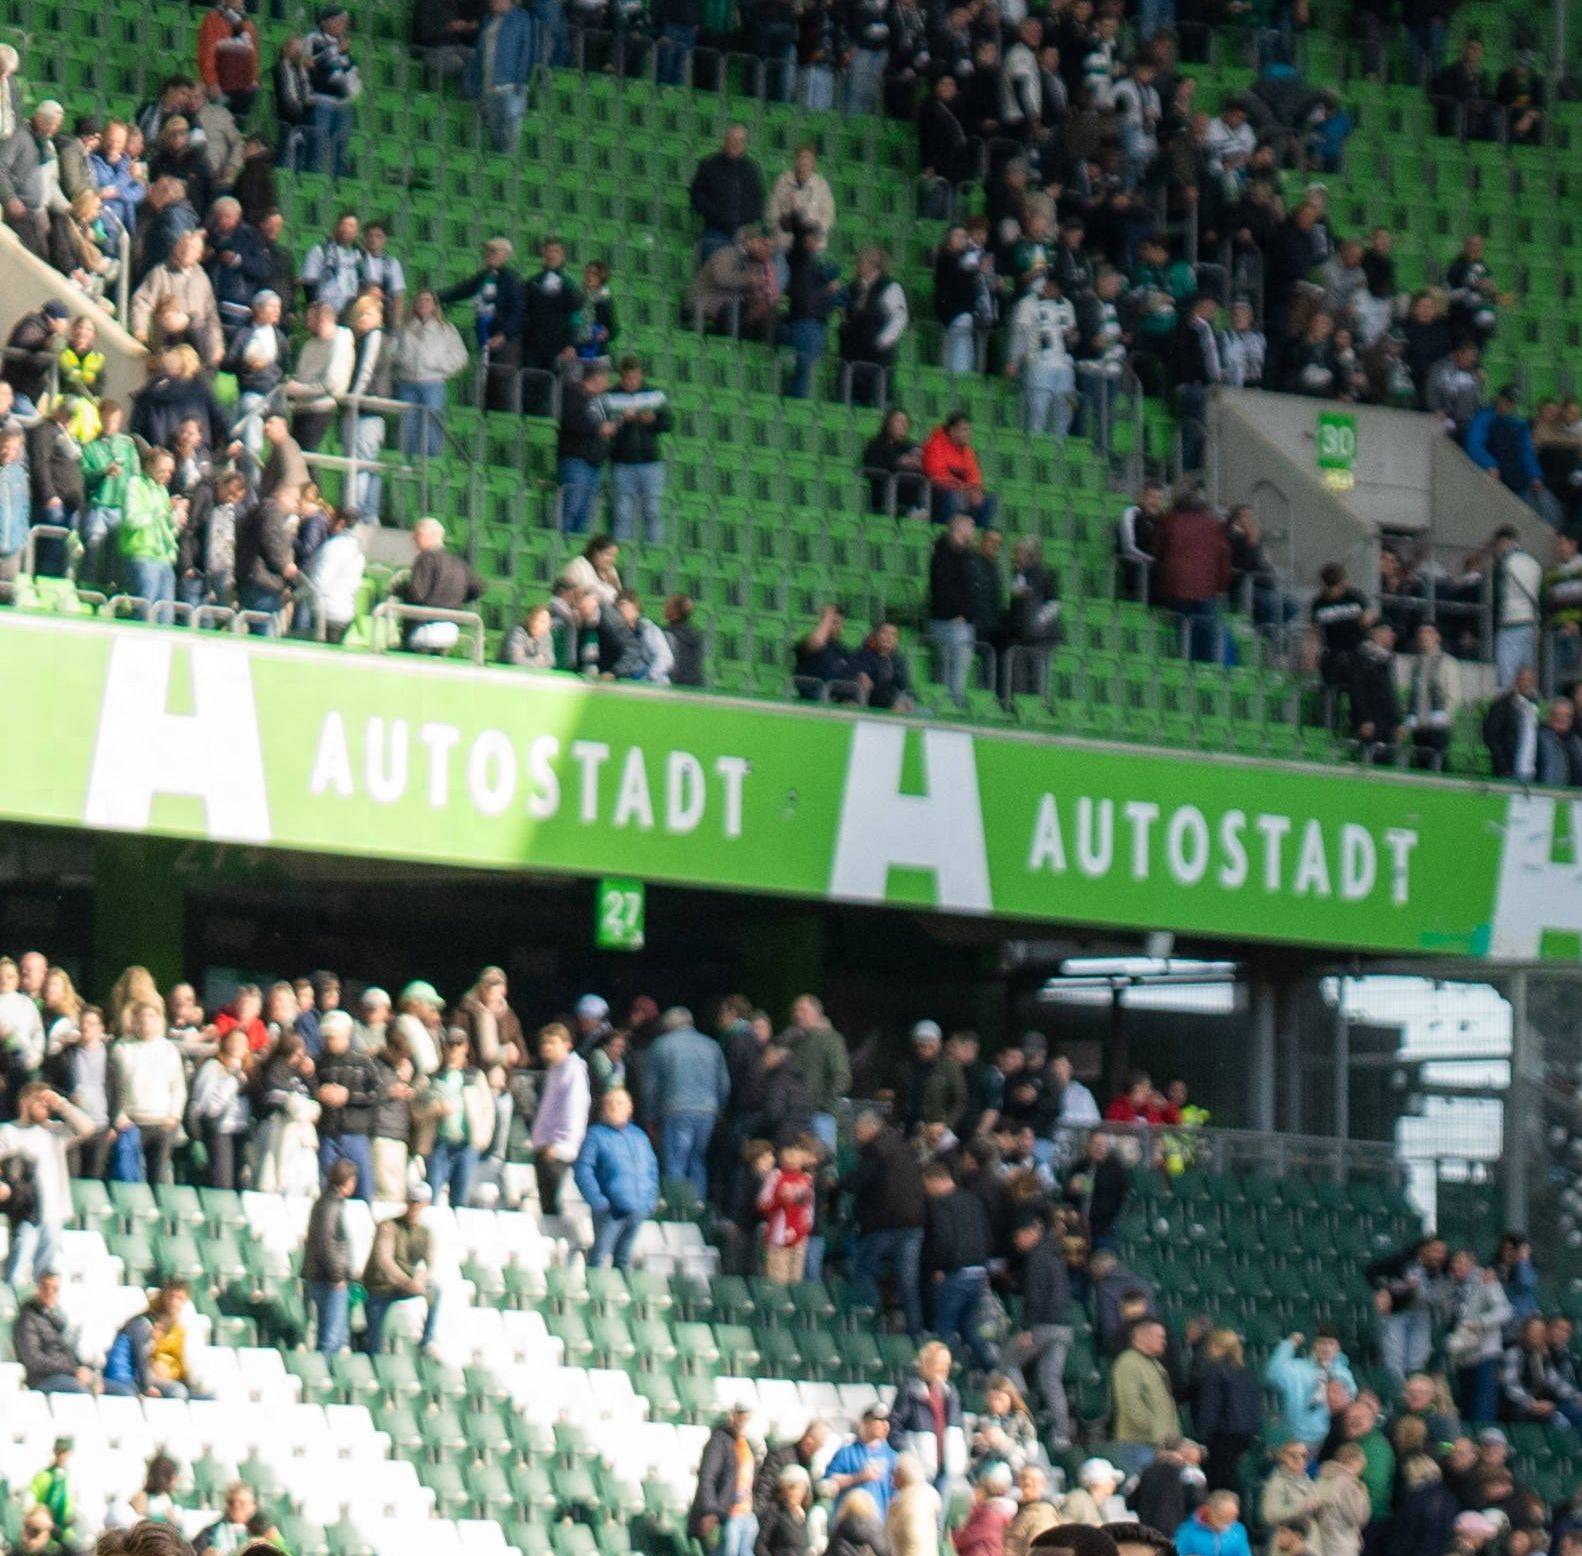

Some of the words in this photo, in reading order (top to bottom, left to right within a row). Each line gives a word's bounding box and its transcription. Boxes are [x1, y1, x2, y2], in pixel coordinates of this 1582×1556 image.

[310, 711, 753, 839] AUTOSTADT
[1028, 790, 1419, 907] AUTOSTADT
[603, 890, 642, 930] 27
